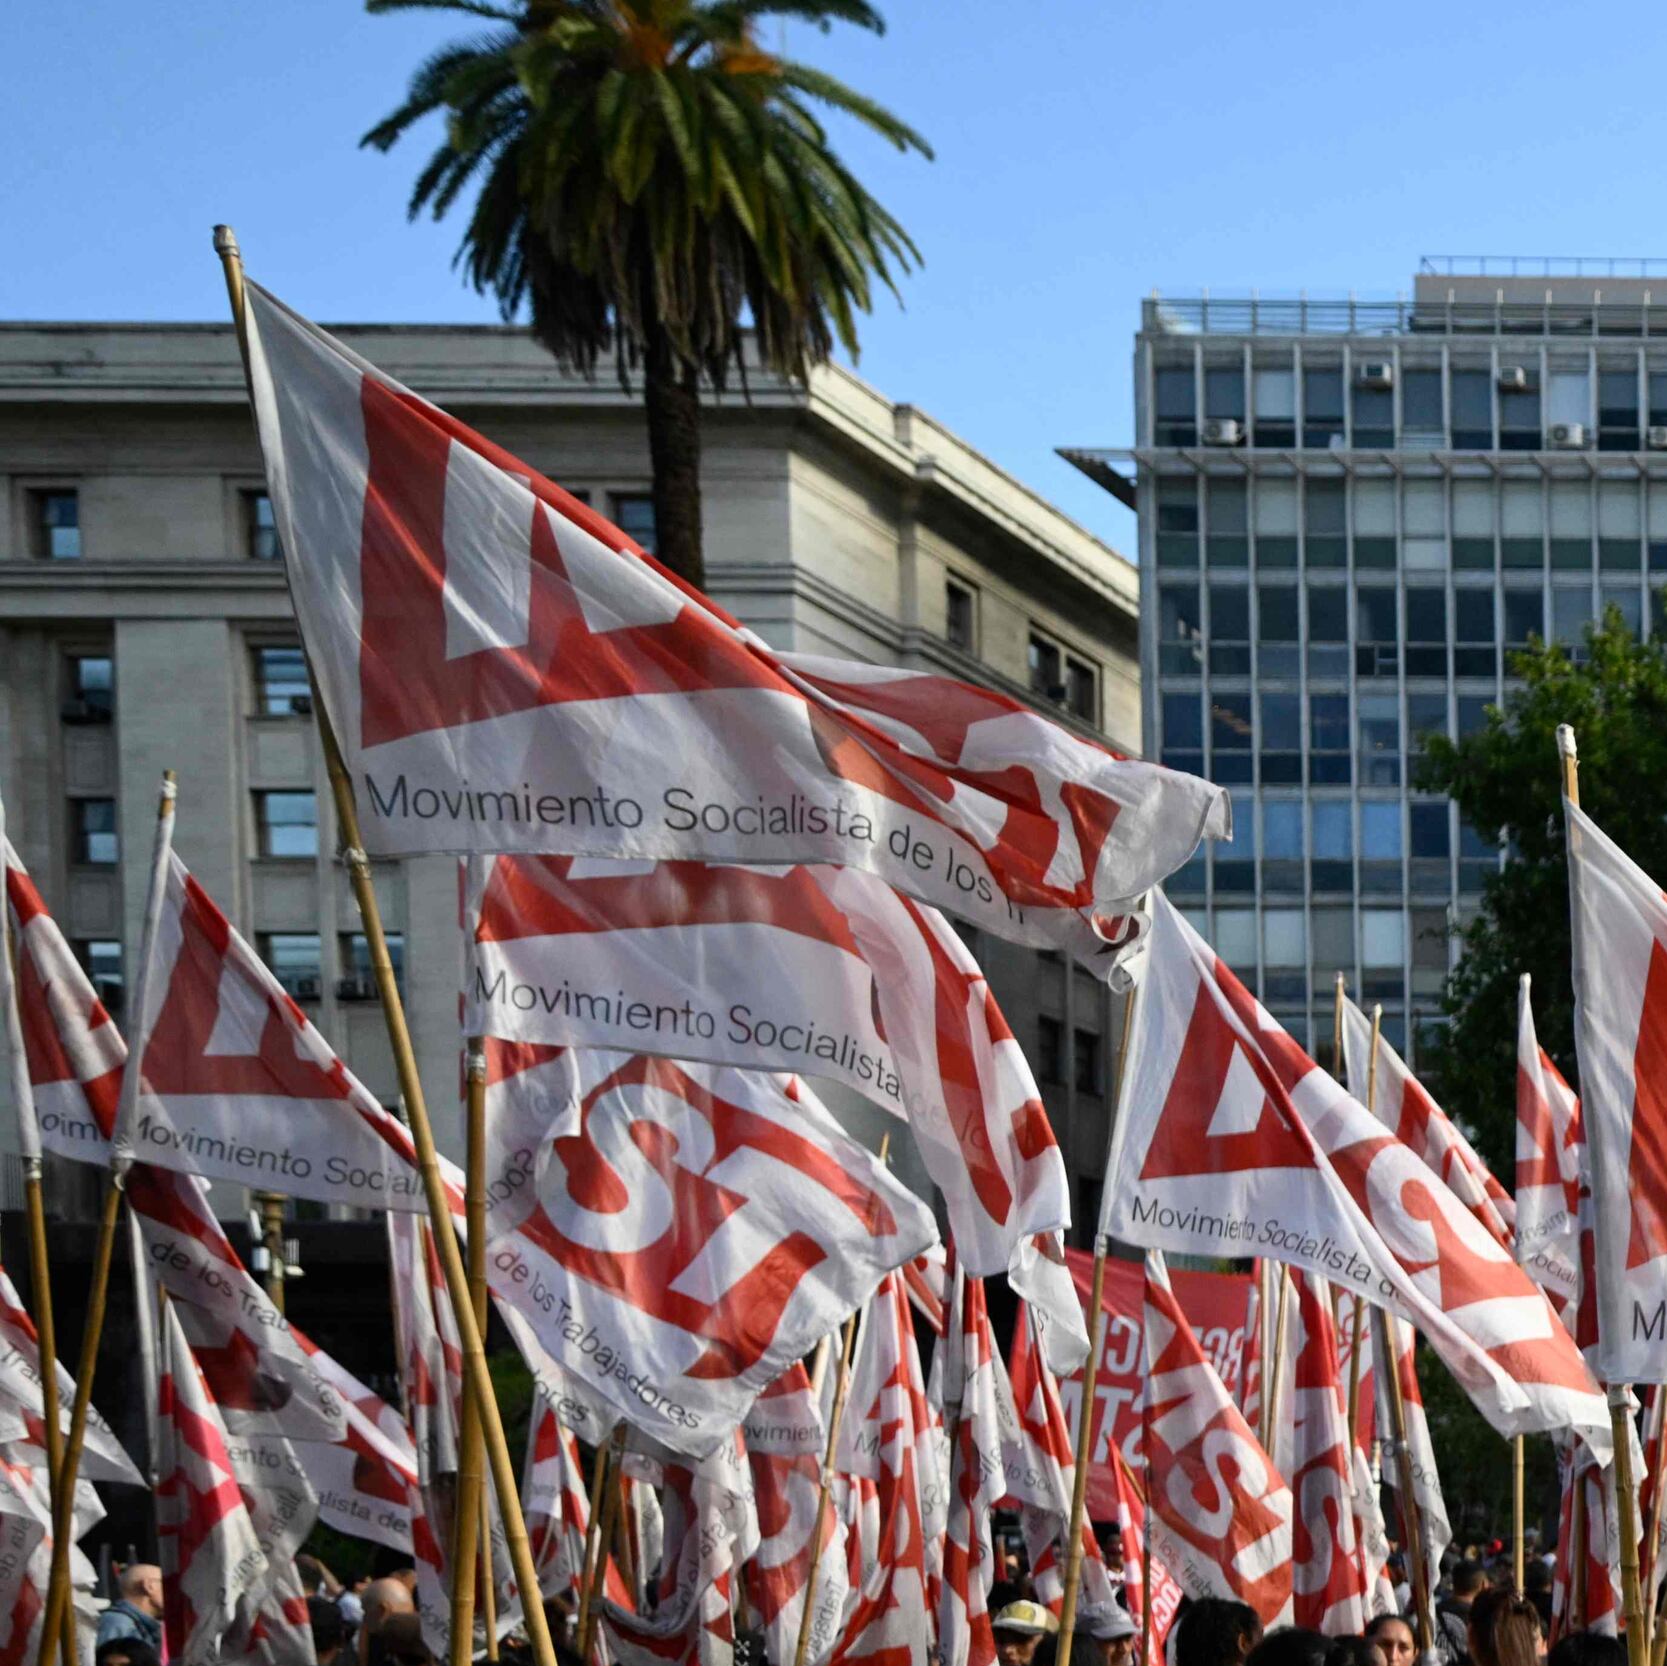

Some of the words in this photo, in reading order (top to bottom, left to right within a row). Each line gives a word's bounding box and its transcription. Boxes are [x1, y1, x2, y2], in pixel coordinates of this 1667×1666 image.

[365, 774, 643, 829] Movimiento
[663, 787, 874, 844] Socialista
[889, 825, 934, 870] de
[946, 848, 993, 903] los
[475, 967, 715, 1040] Movimiento
[728, 1005, 901, 1101] Socialista
[150, 1237, 191, 1273] de
[198, 1257, 235, 1299] los
[1132, 1194, 1256, 1242] Movimiento
[1257, 1218, 1371, 1284] Socialista
[494, 1248, 529, 1284] de
[530, 1272, 554, 1314] los
[553, 1297, 701, 1431] Trabajadores
